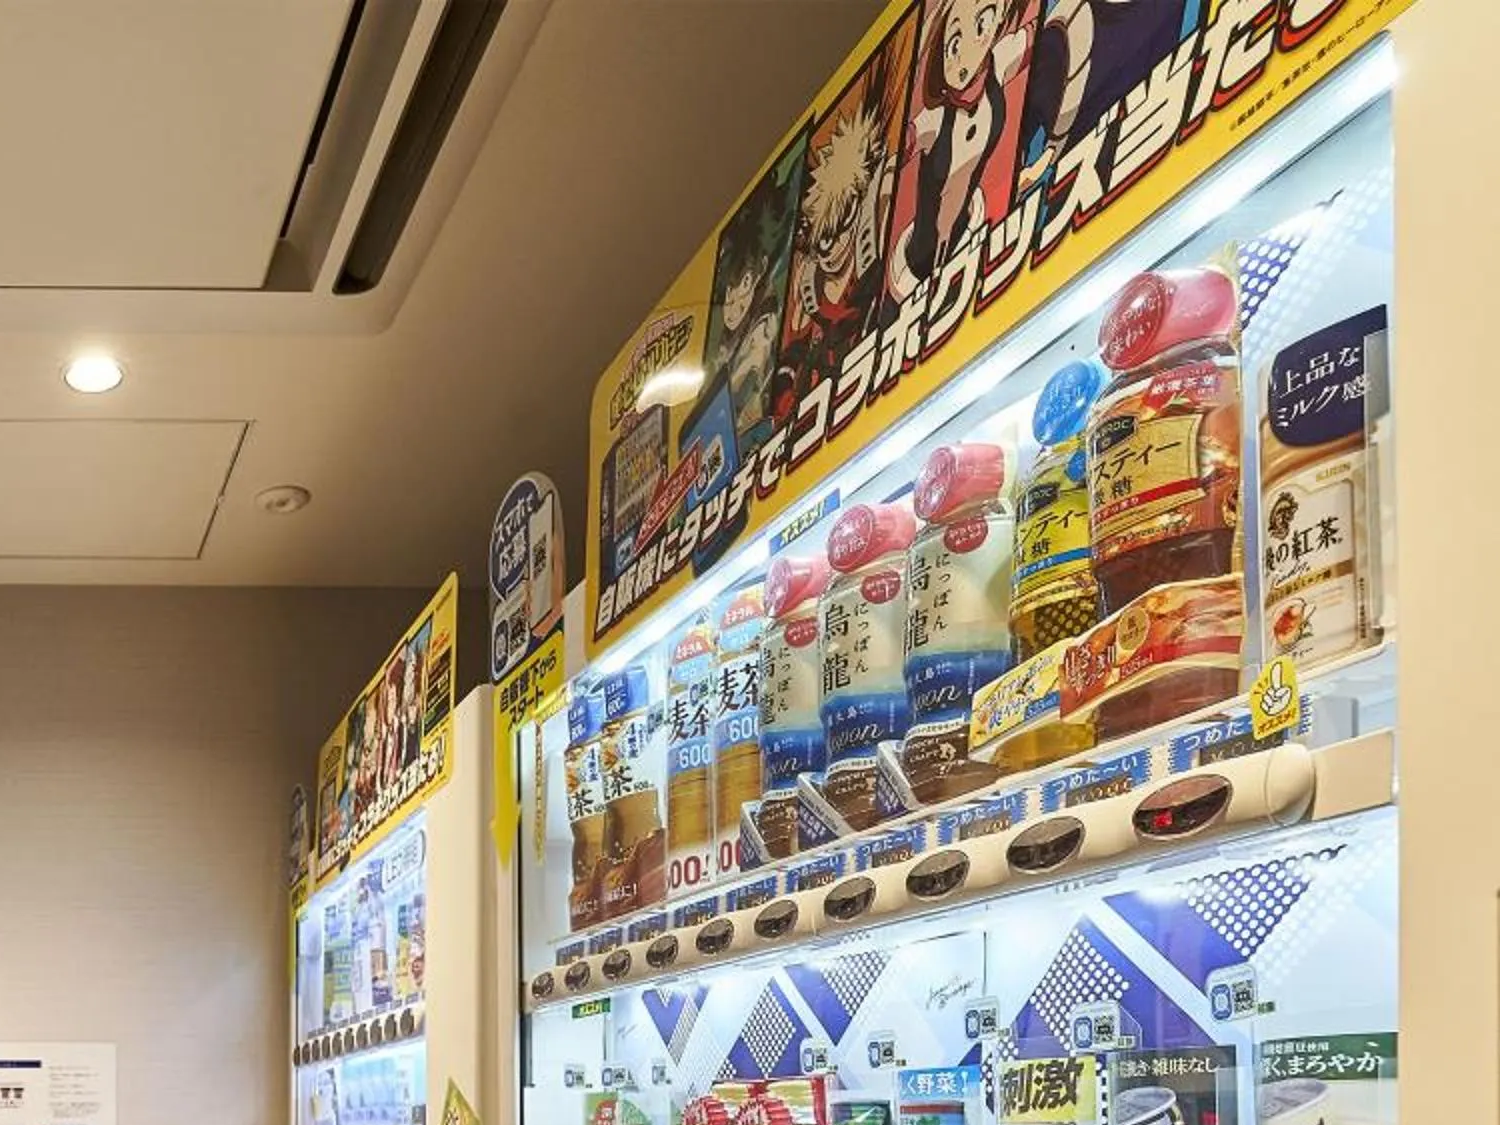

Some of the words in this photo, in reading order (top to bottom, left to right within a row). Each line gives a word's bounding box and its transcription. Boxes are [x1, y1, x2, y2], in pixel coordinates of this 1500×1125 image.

[1279, 347, 1361, 398] 上品な
[1276, 373, 1370, 428] ミルク感
[718, 662, 760, 714] 麦茶
[668, 698, 711, 742] 麦茶
